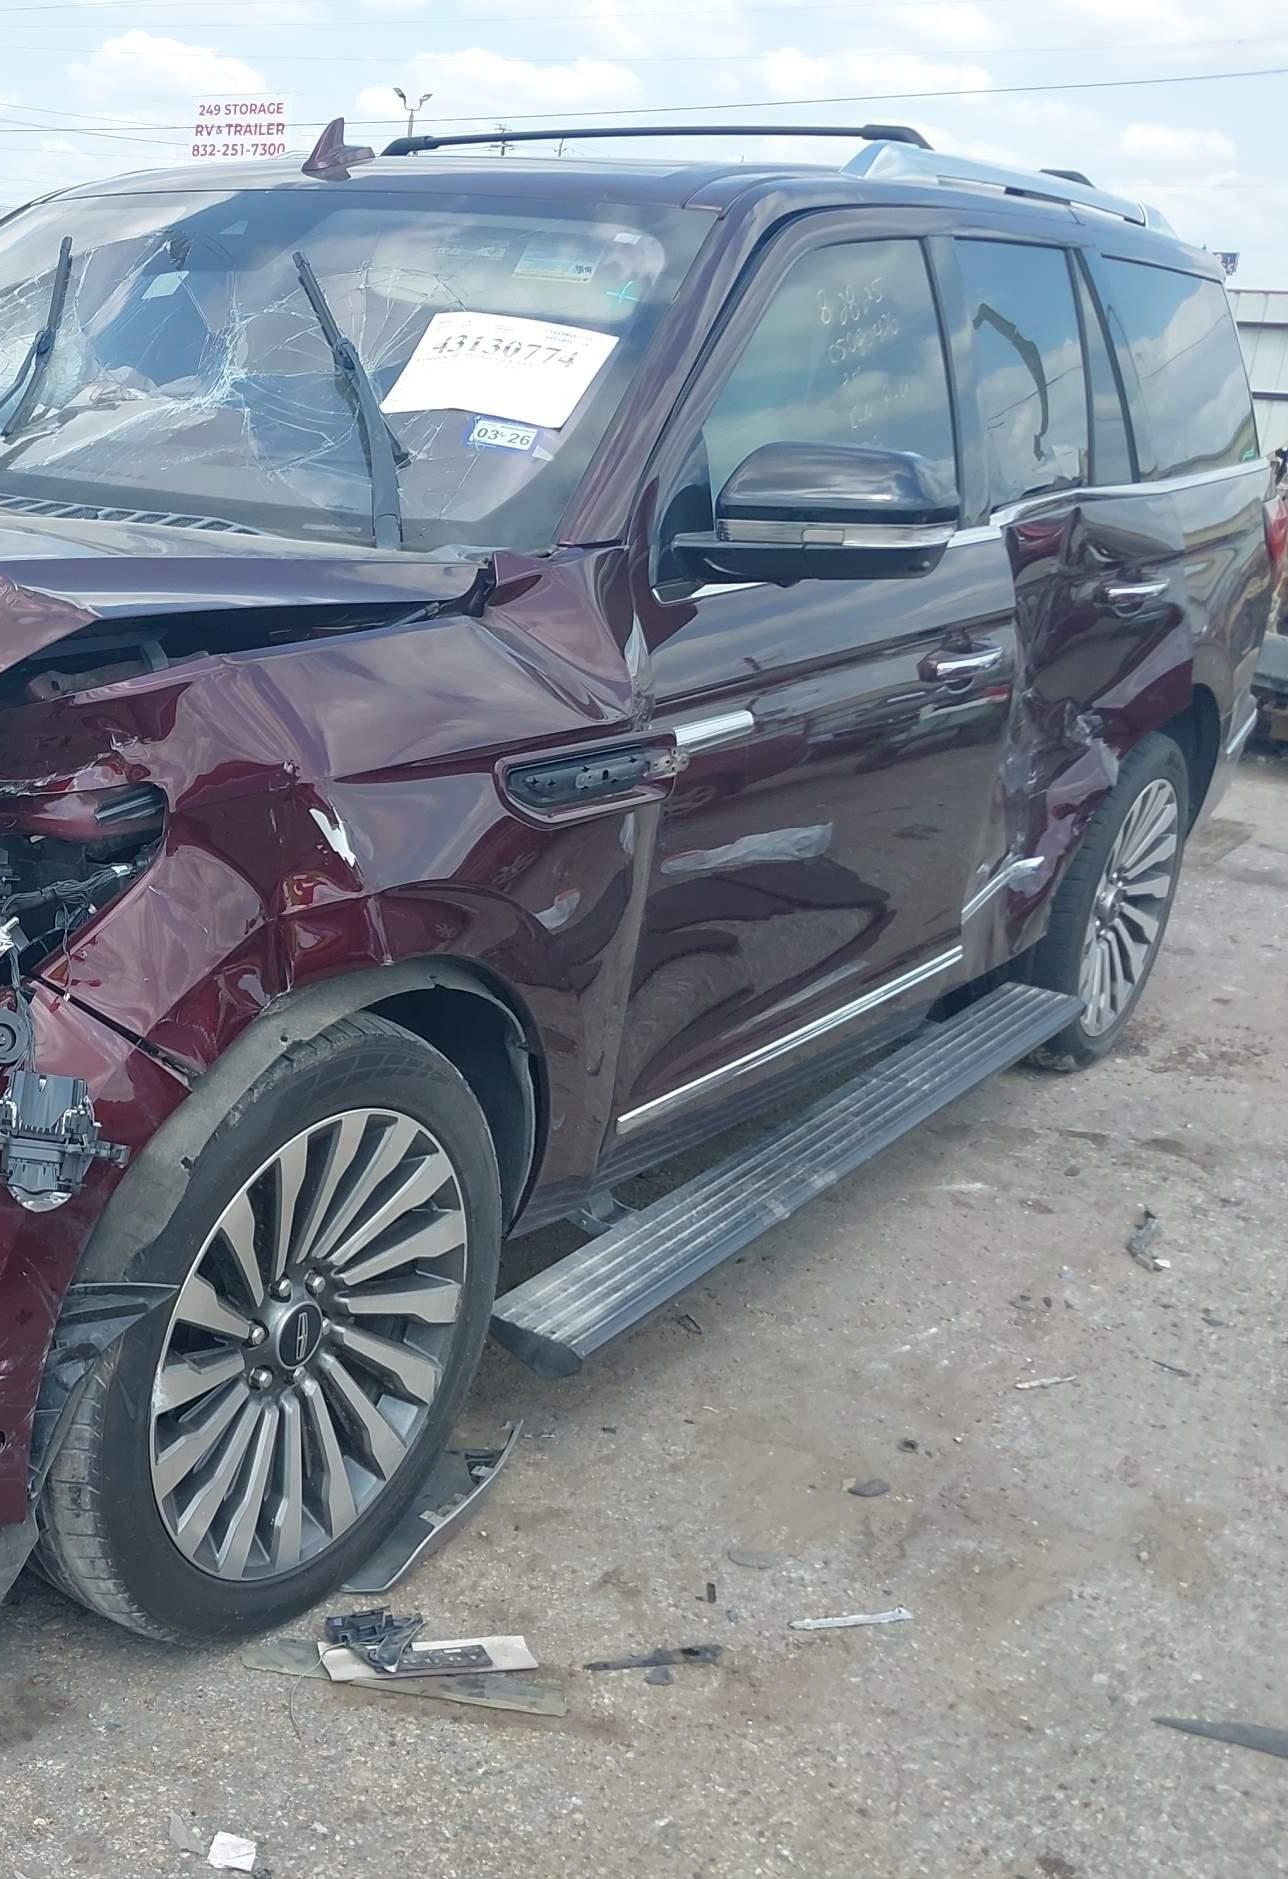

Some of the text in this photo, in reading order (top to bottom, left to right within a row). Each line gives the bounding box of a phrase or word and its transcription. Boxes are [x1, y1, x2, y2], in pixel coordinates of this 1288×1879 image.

[198, 102, 284, 116] 249 STORAGE
[194, 122, 285, 137] RV & TRAILER
[191, 143, 286, 157] 832-251-7300
[476, 427, 532, 446] 03 26
